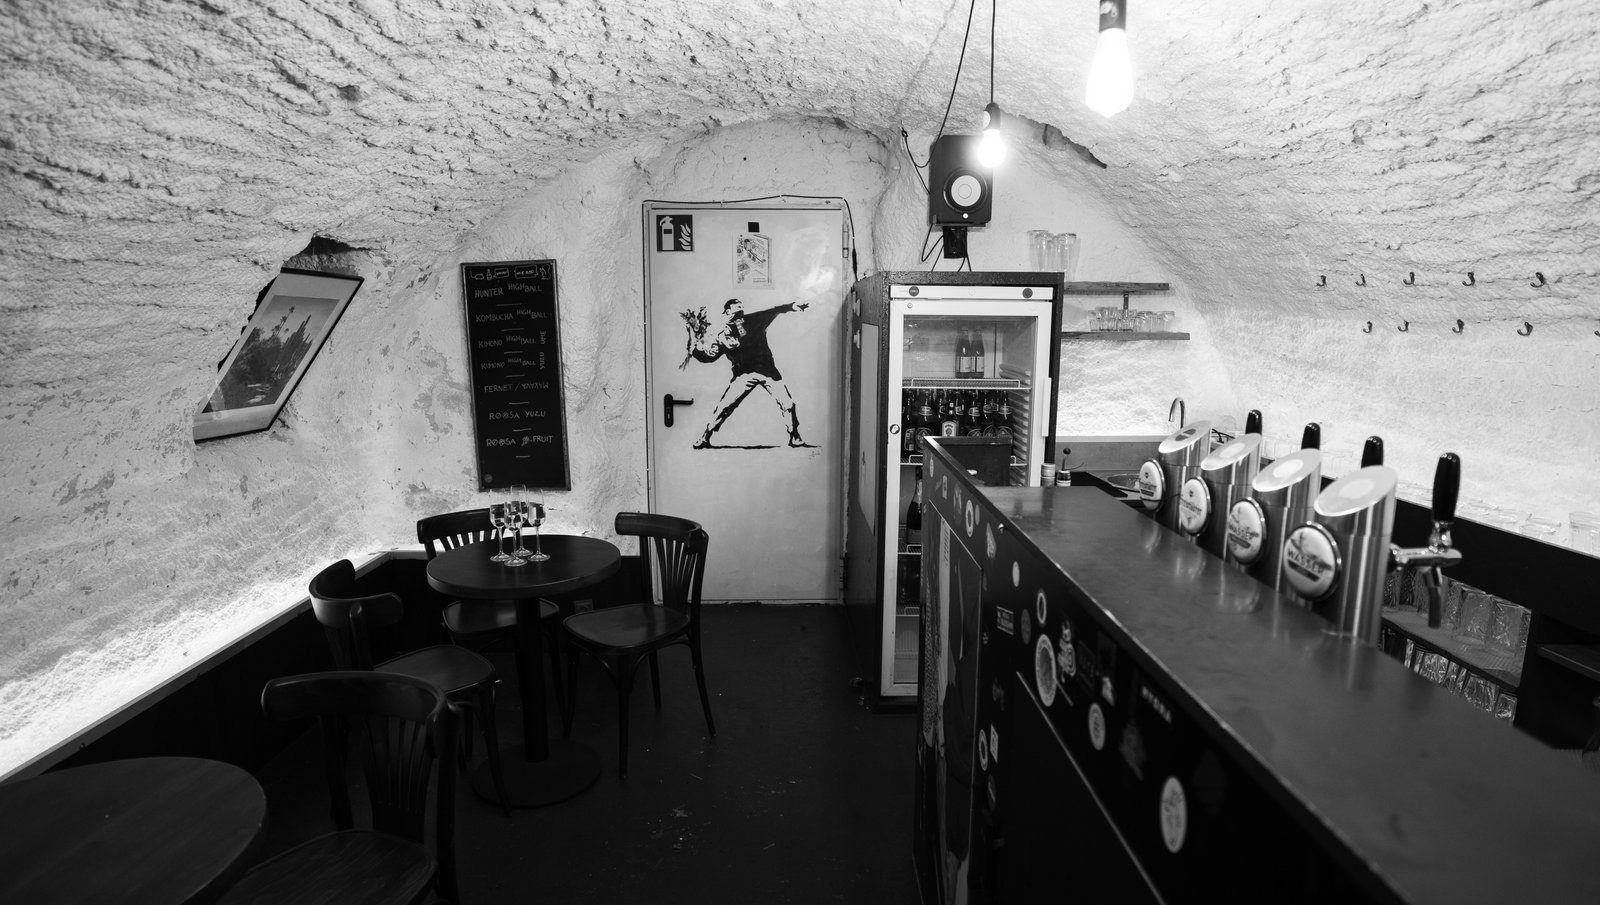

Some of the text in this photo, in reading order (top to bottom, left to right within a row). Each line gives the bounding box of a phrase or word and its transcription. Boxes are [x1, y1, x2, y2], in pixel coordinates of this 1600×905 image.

[474, 288, 504, 298] HUNTER
[476, 312, 514, 323] KOMBUCHA
[478, 339, 503, 349] KIMONO
[481, 361, 506, 370] KIMONO
[484, 383, 512, 393] FERNET
